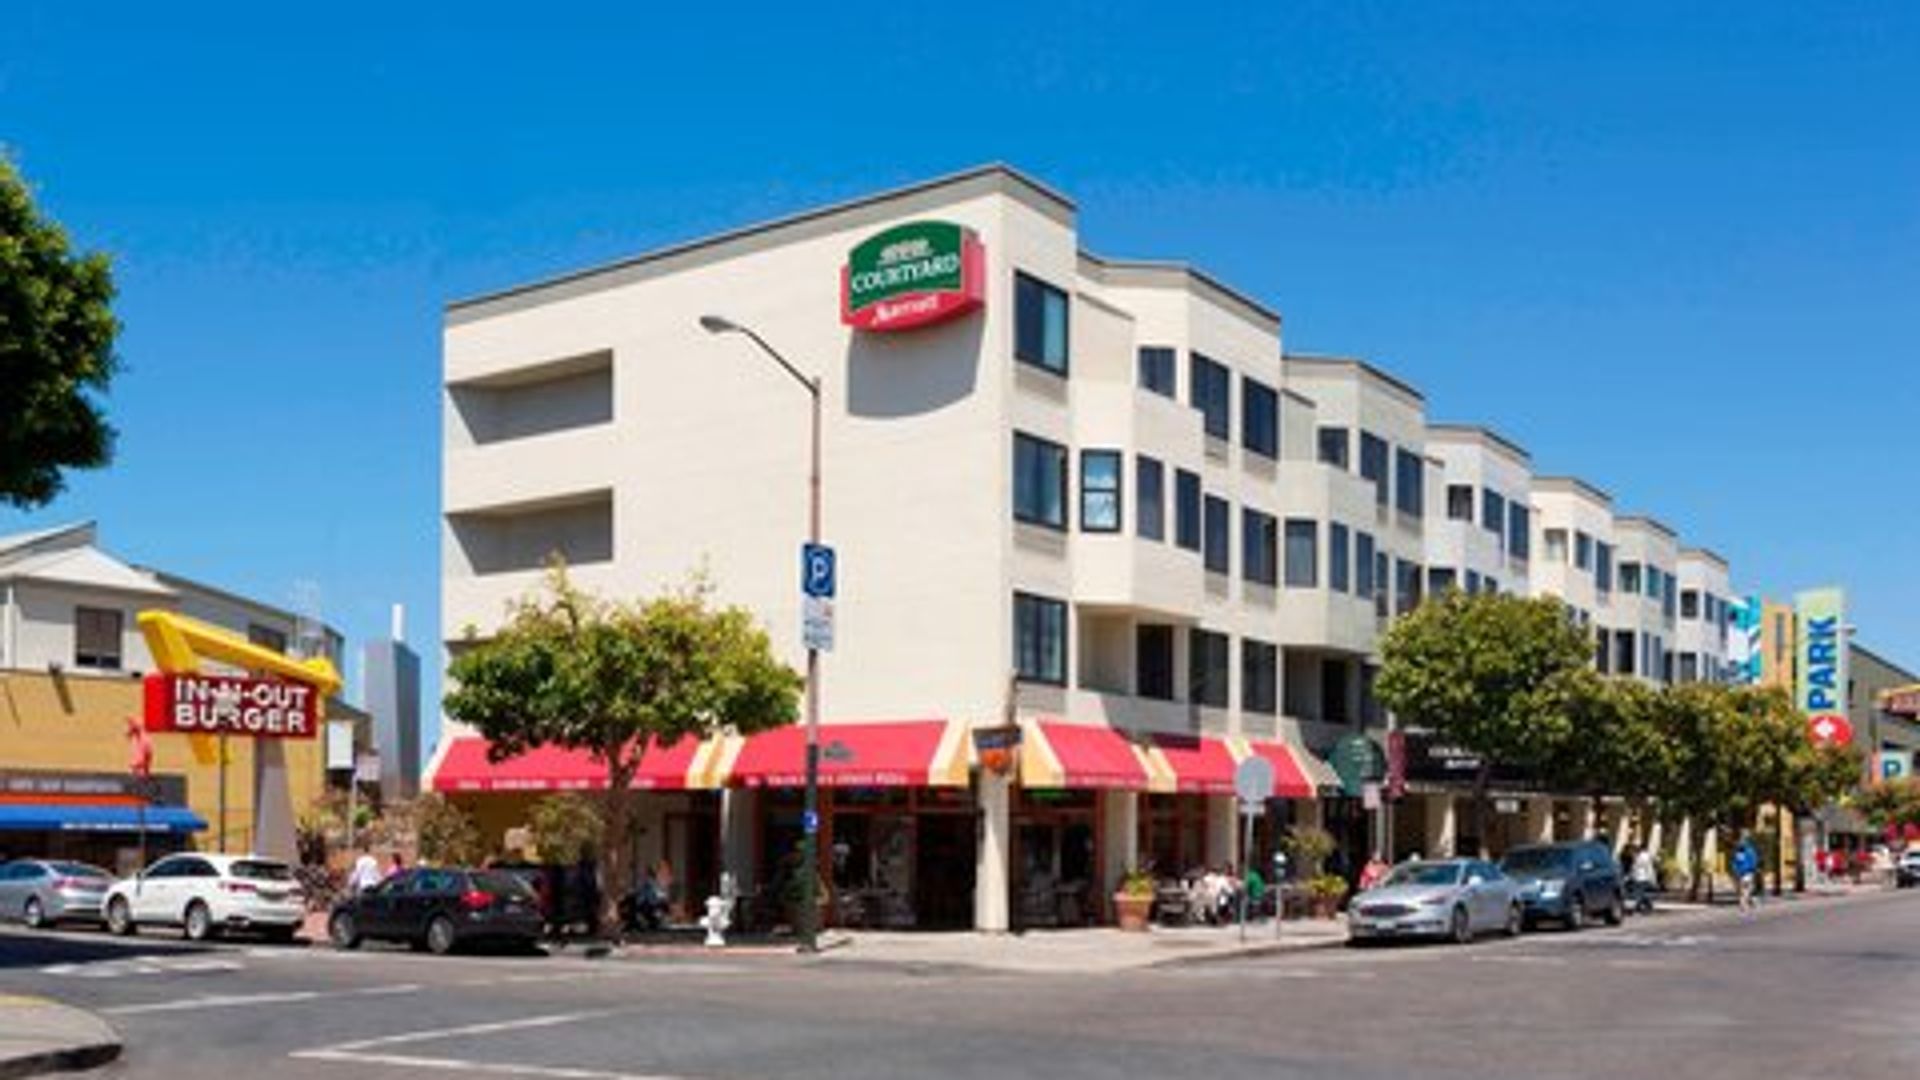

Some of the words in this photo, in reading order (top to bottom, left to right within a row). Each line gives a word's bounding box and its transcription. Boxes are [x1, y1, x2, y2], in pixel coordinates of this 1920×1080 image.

[852, 252, 960, 293] COURTYARD
[1807, 615, 1837, 709] PARK
[175, 677, 309, 709] IN-N-OUT
[175, 703, 306, 733] BURGER
